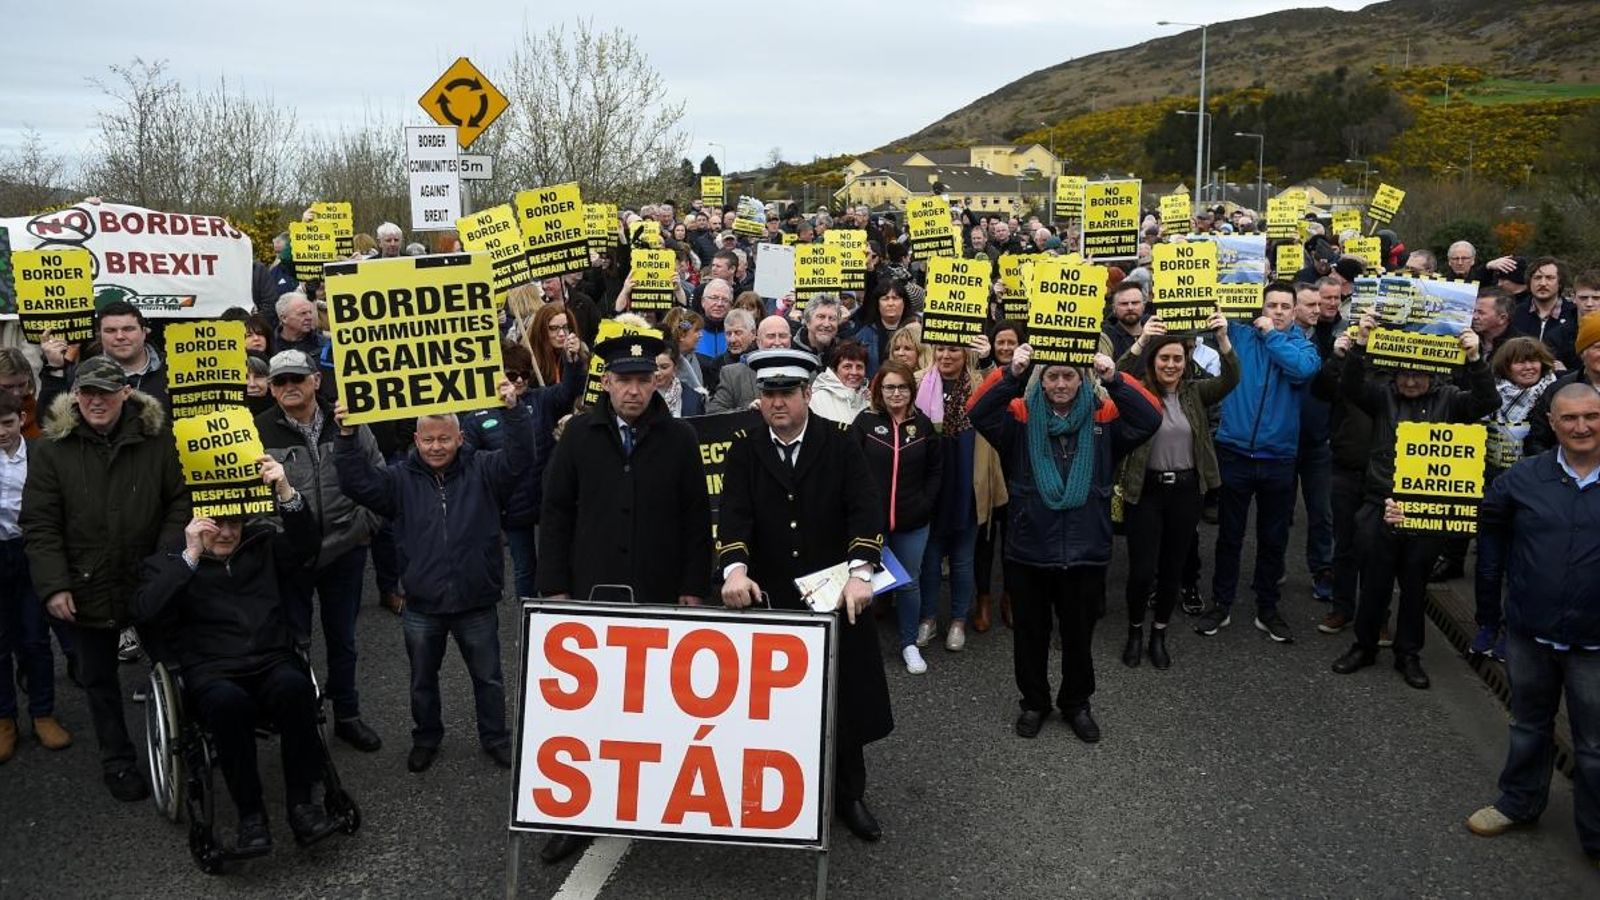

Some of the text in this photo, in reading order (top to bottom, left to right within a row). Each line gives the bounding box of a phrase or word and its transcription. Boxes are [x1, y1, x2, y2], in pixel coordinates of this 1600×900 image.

[418, 135, 447, 147] BORDER
[410, 160, 457, 172] COMMUNITIES
[421, 184, 449, 197] AGAINST
[1105, 187, 1119, 196] NO
[540, 192, 557, 203] NO
[1091, 196, 1132, 206] BORDER
[425, 209, 448, 222] BREXIT
[526, 201, 574, 218] BORDER
[912, 208, 945, 218] BORDER
[1104, 210, 1118, 218] NO
[99, 211, 242, 239] BORDERS
[477, 215, 492, 226] NO
[544, 219, 562, 230] NO
[1089, 220, 1133, 229] BARRIER
[467, 221, 510, 241] BORDER
[529, 228, 581, 246] BARRIER
[913, 227, 949, 237] BARRIER
[485, 238, 501, 250] NO
[1085, 236, 1119, 244] RESPECT
[530, 250, 568, 264] RESPECT
[571, 246, 587, 256] THE
[1085, 247, 1115, 255] REMAIN
[1176, 247, 1193, 257] NO
[41, 256, 62, 266] NO
[104, 252, 218, 276] BREXIT
[636, 261, 669, 269] BORDER
[800, 256, 836, 264] BORDER
[1160, 259, 1210, 271] BORDER
[532, 258, 590, 277] REMAIN VOTE
[952, 263, 968, 273] NO
[22, 268, 83, 280] BORDER
[1061, 269, 1080, 280] NO
[1177, 275, 1194, 285] NO
[799, 277, 838, 285] BARRIER
[935, 274, 982, 287] BORDER
[44, 286, 65, 296] NO
[949, 290, 965, 300] NO
[1040, 281, 1098, 297] BORDER
[1159, 287, 1212, 299] BARRIER
[24, 298, 88, 310] BARRIER
[332, 282, 492, 324] BORDER
[1226, 296, 1257, 304] BREXIT
[931, 300, 981, 314] BARRIER
[1057, 301, 1076, 312] NO
[1157, 307, 1196, 318] RESPECT
[24, 317, 92, 330] RESPECT THE
[925, 319, 982, 332] RESPECT THE
[1035, 313, 1096, 328] BARRIER
[67, 330, 92, 340] VOTE
[195, 327, 216, 338] NO
[337, 314, 494, 345] COMMUNITIES
[924, 331, 958, 342] REMAIN
[1030, 334, 1096, 349] RESPECT THE
[1375, 333, 1460, 348] BORDER COMMUNITIES
[176, 340, 236, 353] BORDER
[1373, 341, 1460, 359] AGAINST BREXIT
[196, 356, 217, 368] NO
[343, 335, 495, 377] AGAINST
[1070, 353, 1095, 364] VOTE
[1436, 366, 1452, 374] VOTE
[175, 370, 240, 384] BARRIER
[345, 366, 500, 414] BREXIT
[172, 390, 244, 404] RESPECT THE
[172, 404, 216, 417] REMAIN
[207, 418, 229, 432] NO
[188, 430, 252, 451] BORDER
[1430, 429, 1453, 442] NO
[1406, 443, 1475, 458] BORDER
[214, 452, 238, 467] NO
[1428, 464, 1450, 476] NO
[1402, 478, 1475, 493] BARRIER
[192, 486, 272, 502] RESPECT THE
[193, 501, 274, 518] REMAIN VOTE
[1398, 501, 1478, 516] RESPECT THE
[1446, 521, 1477, 533] VOTE
[540, 622, 809, 720] STOP
[532, 724, 804, 830] STÁD
